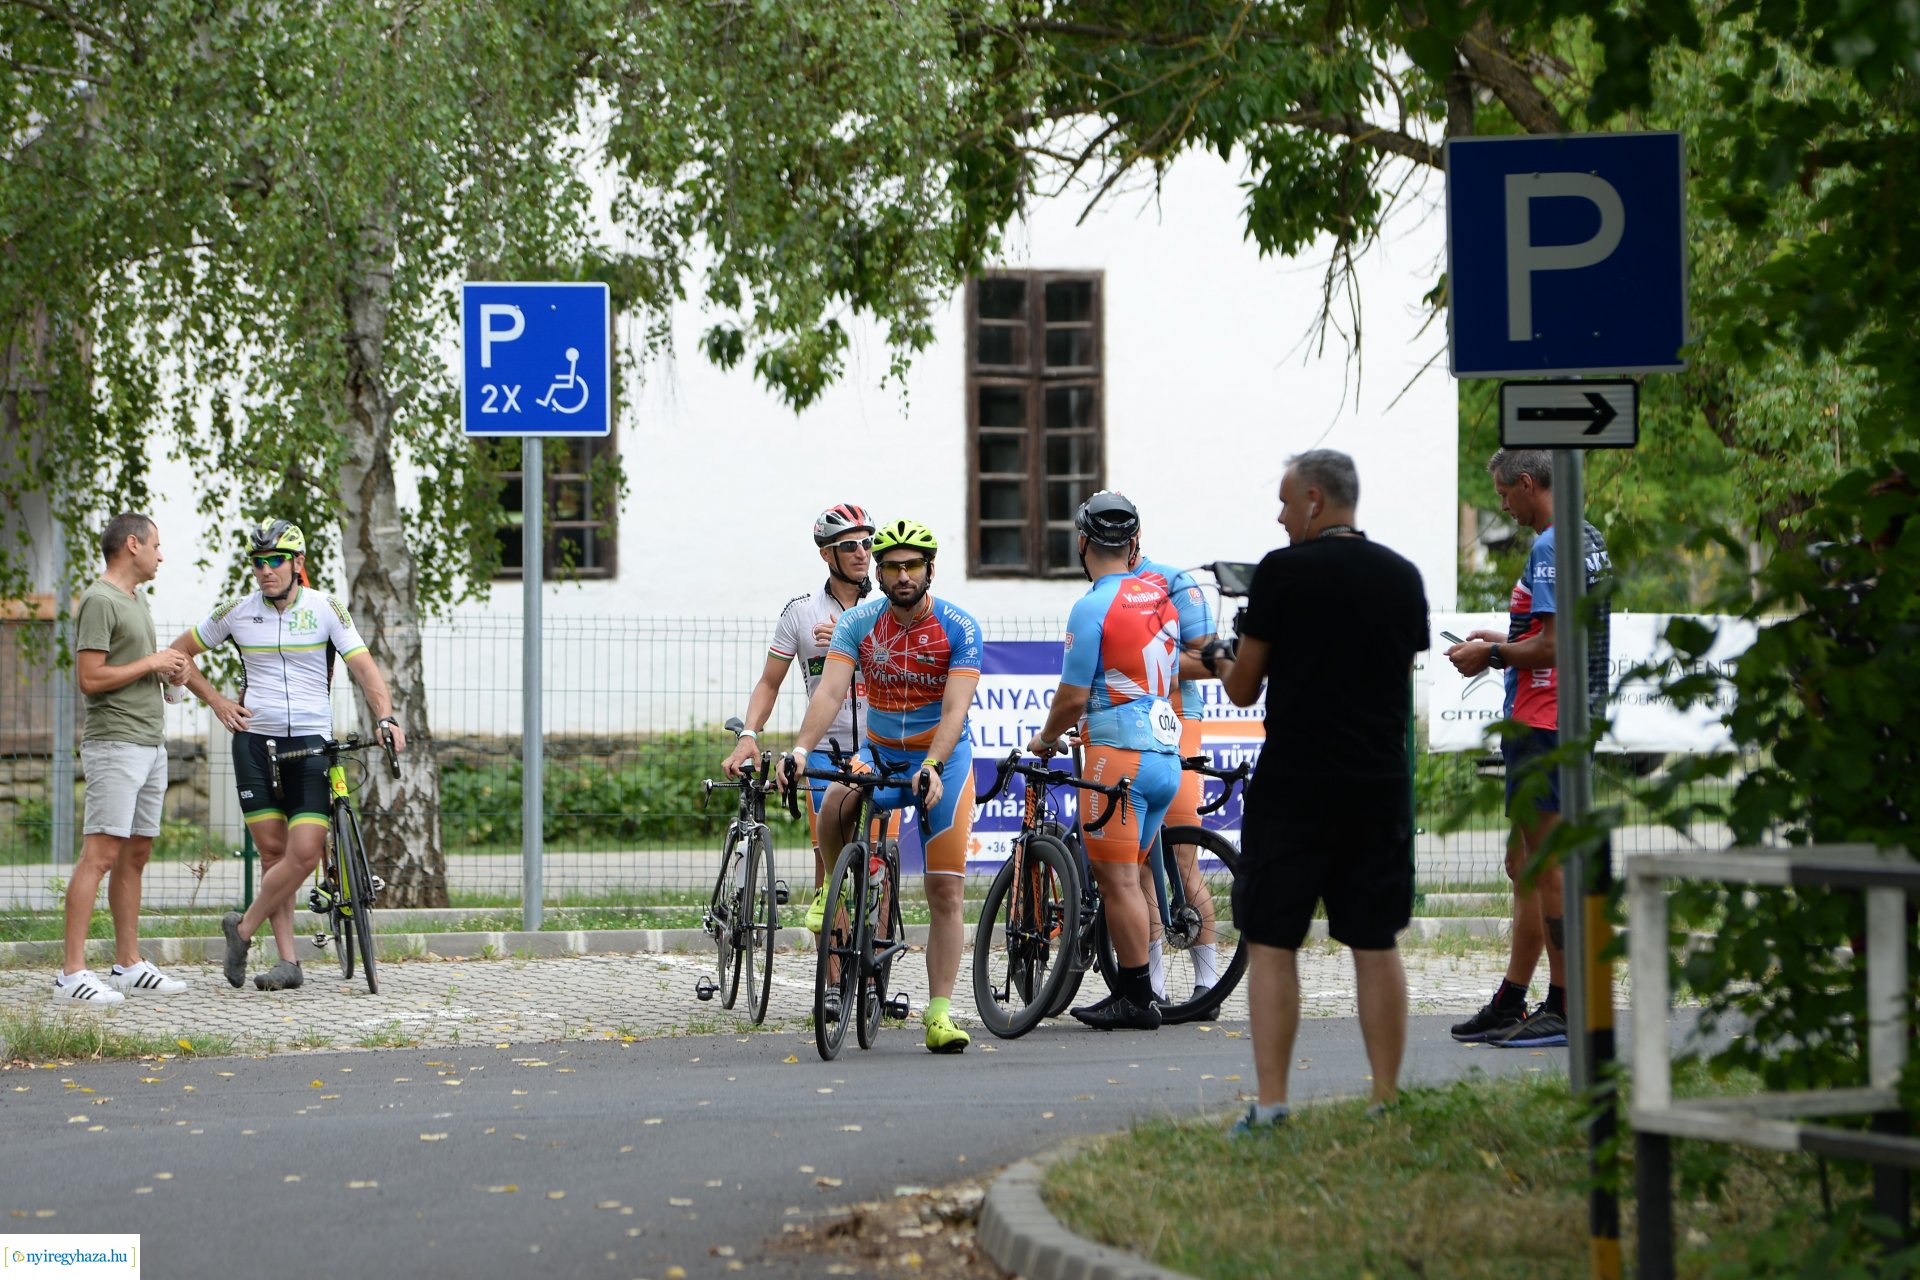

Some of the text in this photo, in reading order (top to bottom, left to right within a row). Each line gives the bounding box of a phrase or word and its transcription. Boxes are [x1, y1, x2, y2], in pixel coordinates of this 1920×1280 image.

[1505, 172, 1626, 341] P
[480, 304, 525, 368] P
[481, 384, 521, 413] 2X
[1123, 591, 1161, 603] ViniBike
[840, 602, 884, 629] ViniBike
[943, 605, 976, 645] ViniBike
[870, 669, 949, 685] ViniBike
[1089, 757, 1107, 823] vinibe.hu
